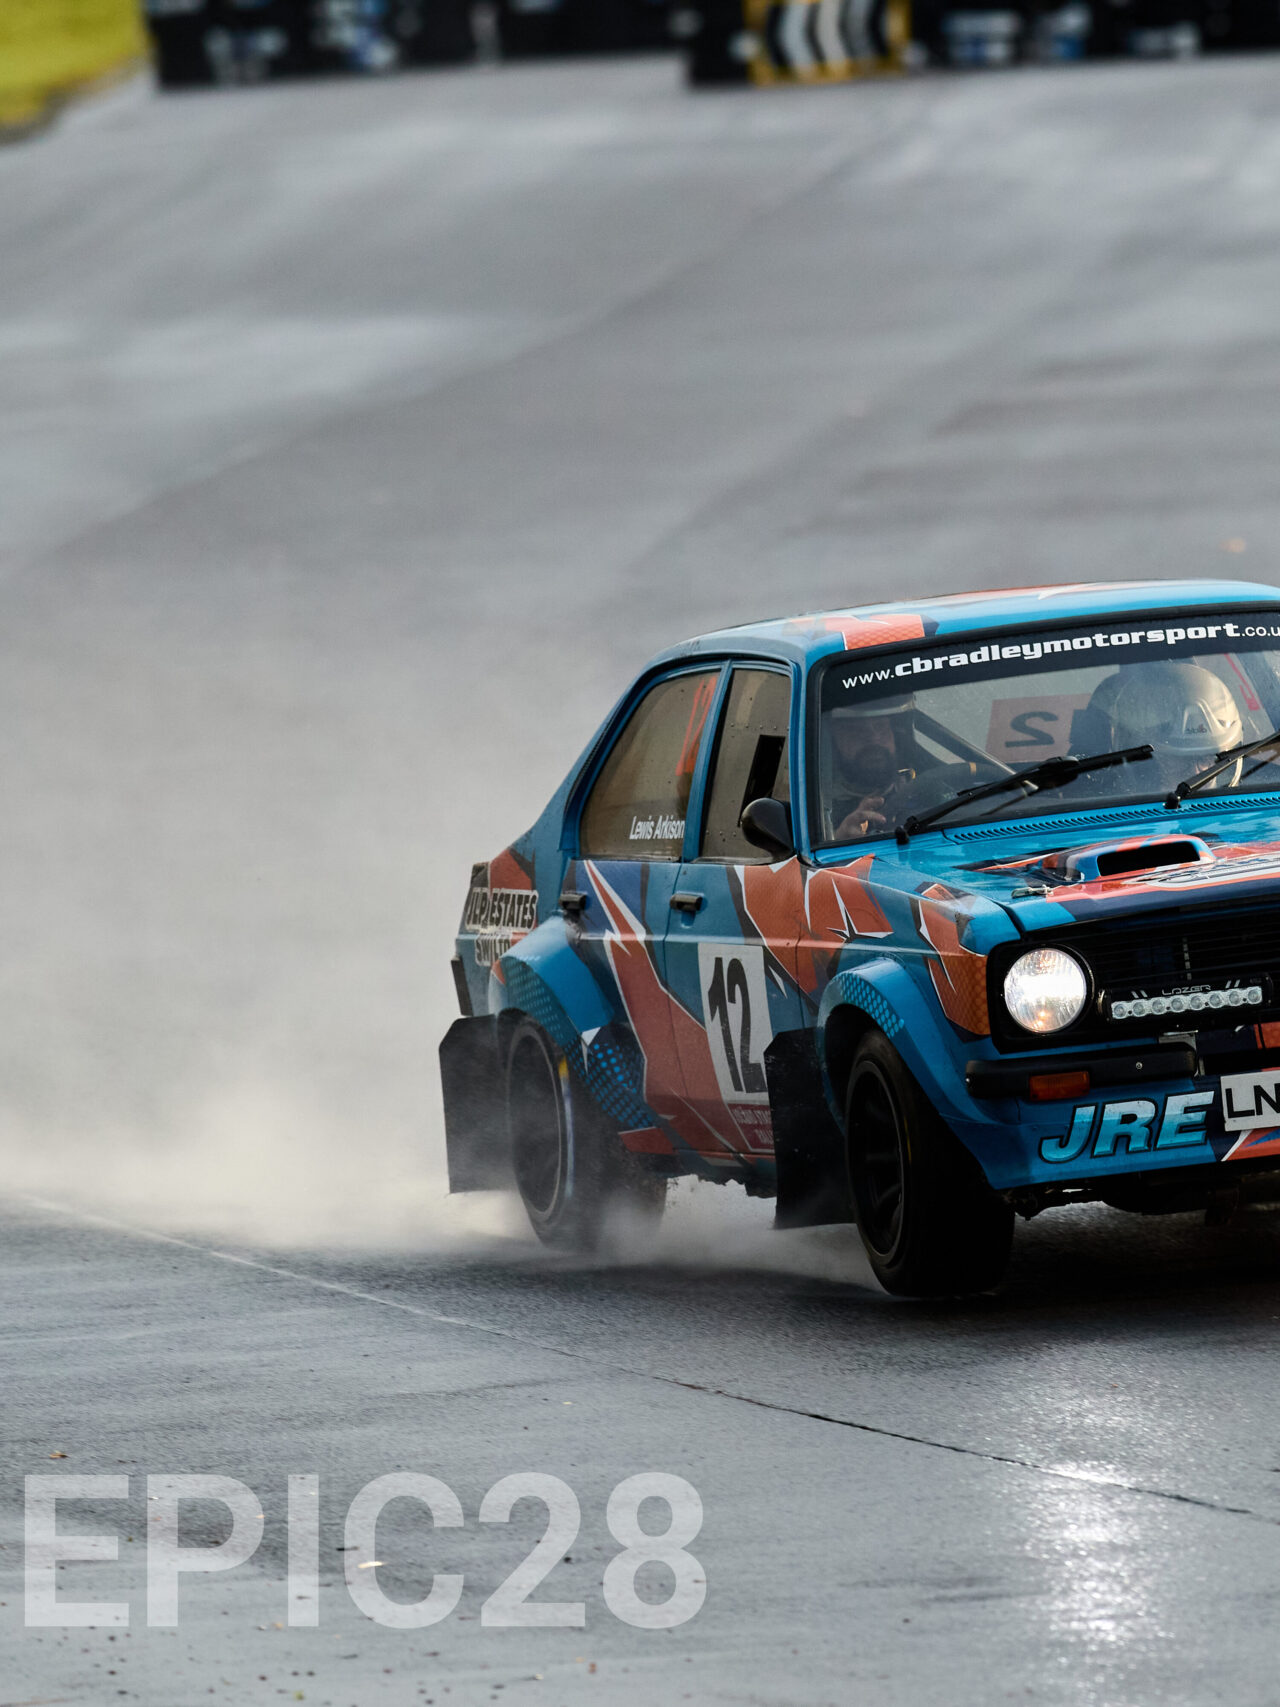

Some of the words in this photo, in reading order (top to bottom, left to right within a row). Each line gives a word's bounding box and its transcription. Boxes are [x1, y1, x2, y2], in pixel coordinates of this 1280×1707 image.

[629, 816, 655, 840] Lewis
[489, 892, 538, 929] ESTATES
[1161, 984, 1212, 996] LAZER
[708, 956, 768, 1093] 12
[1039, 1090, 1215, 1164] JRE
